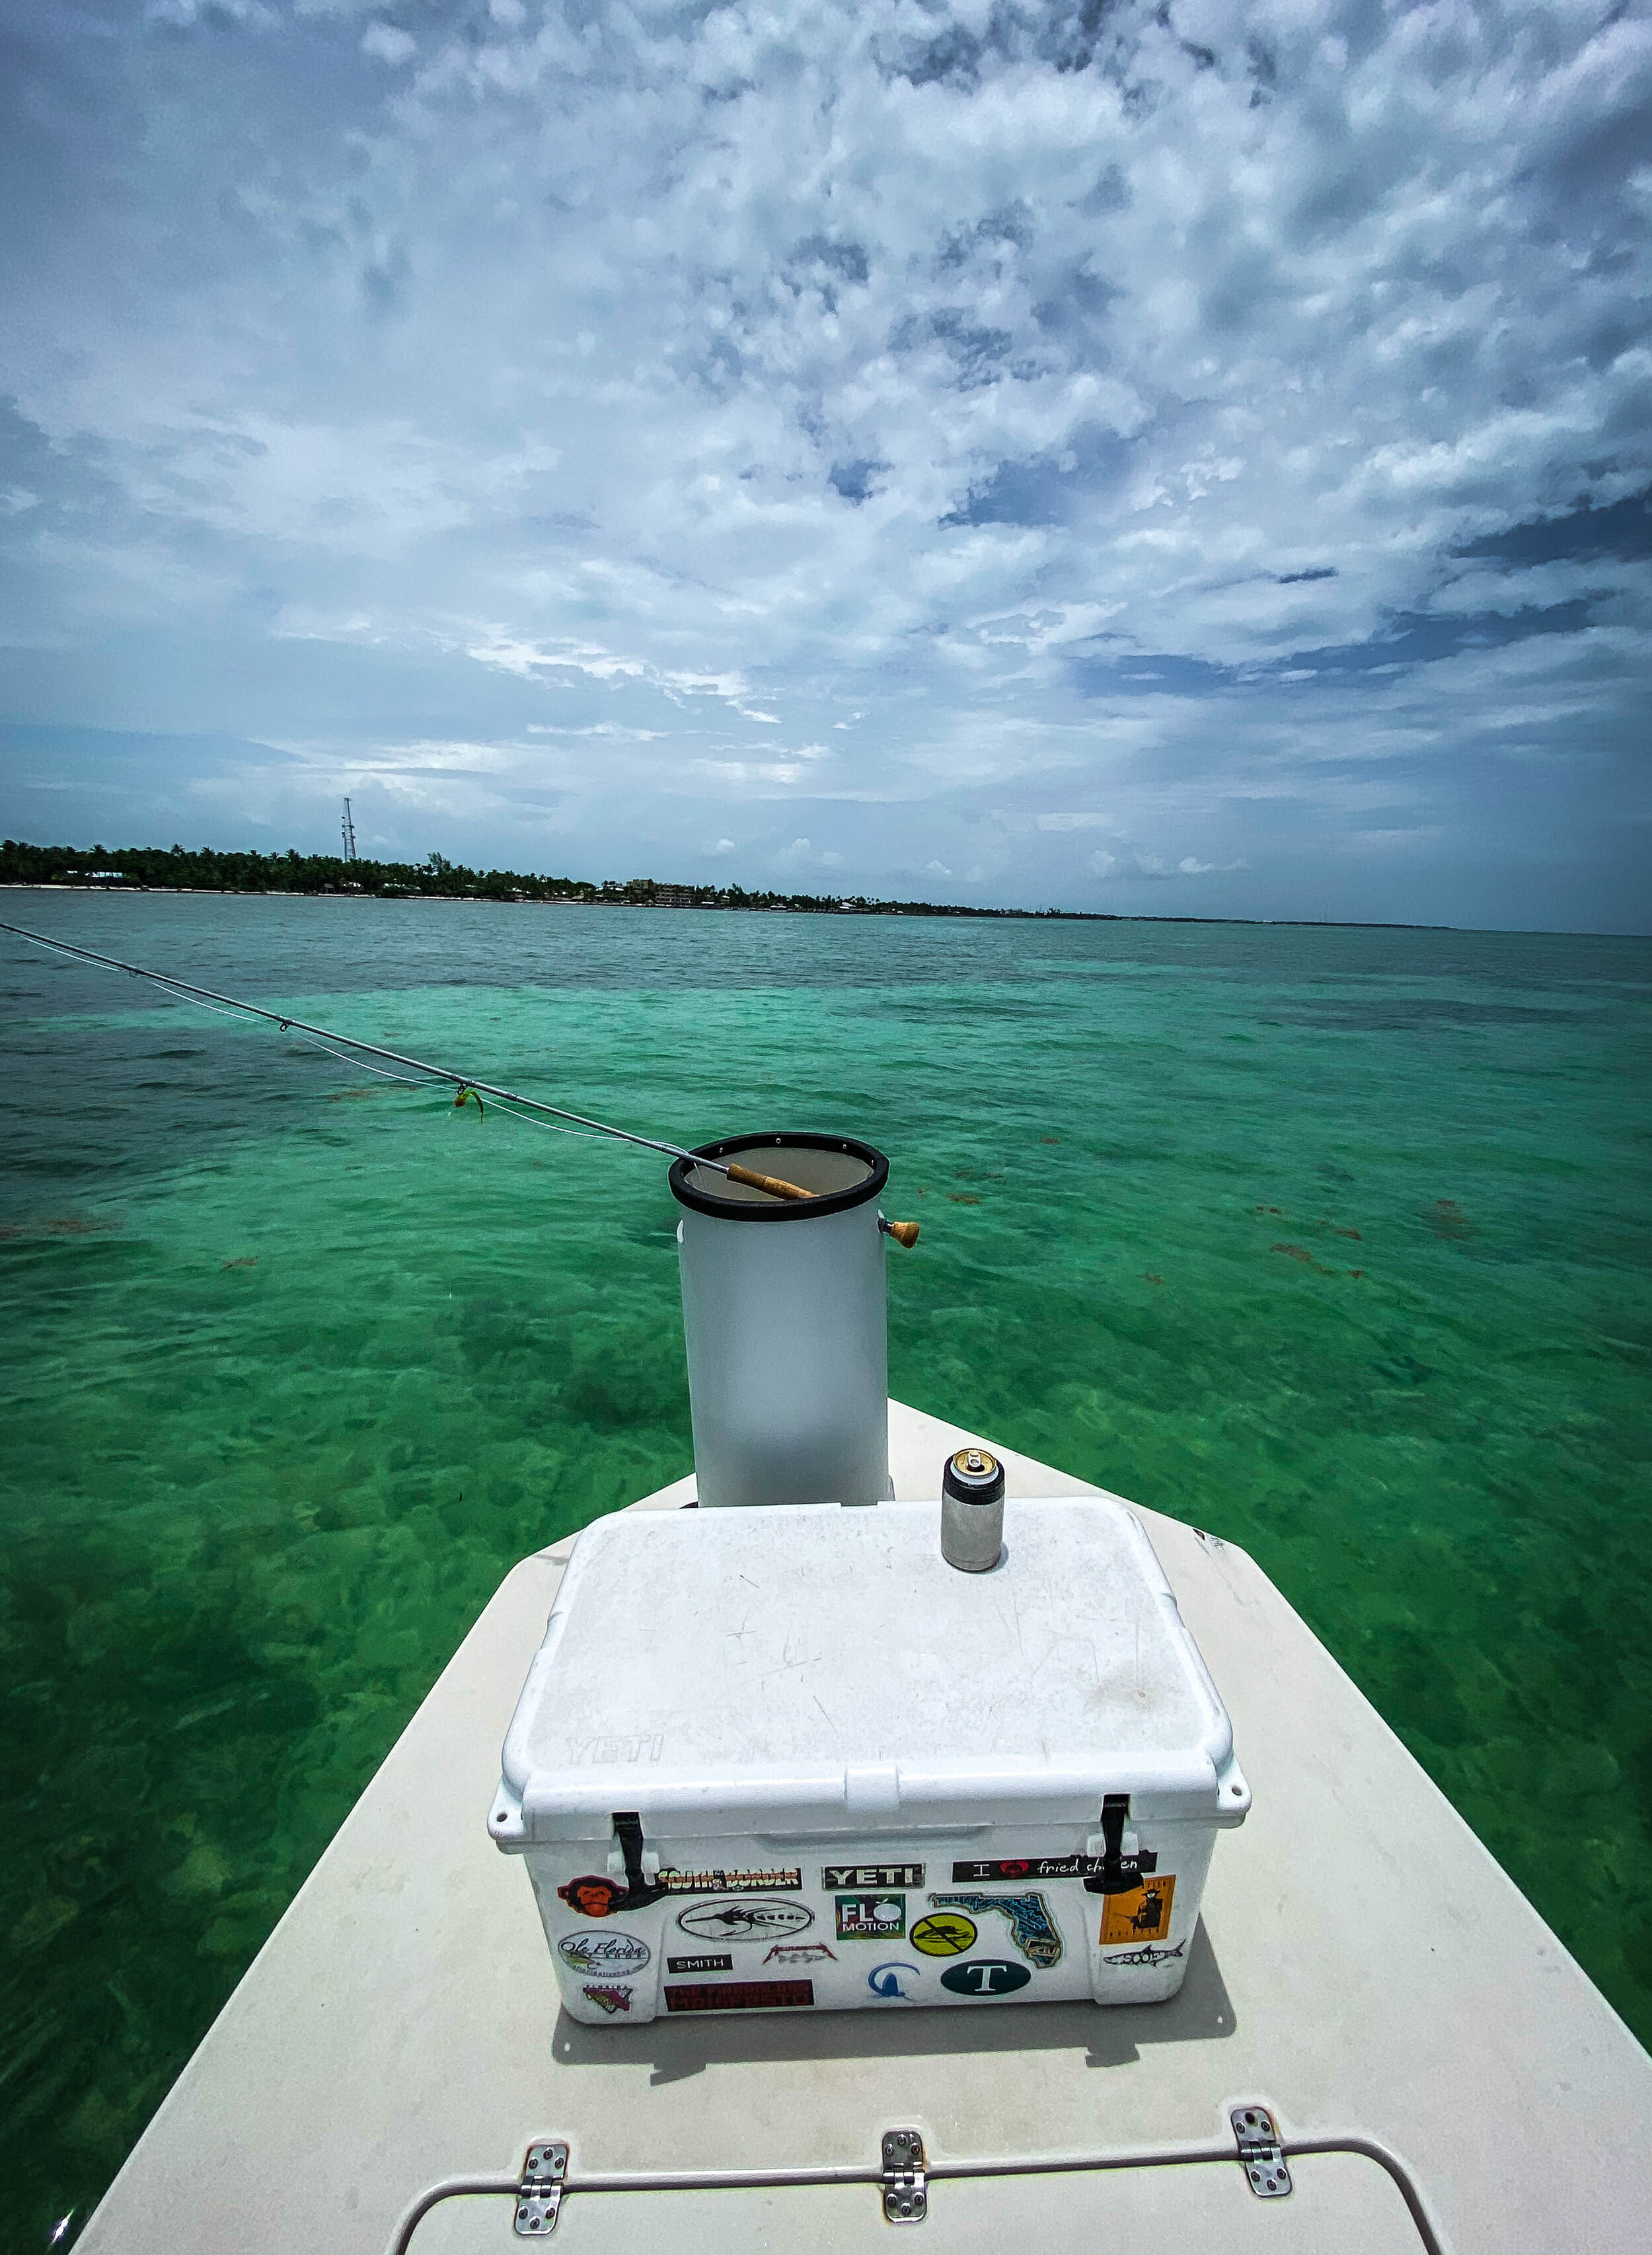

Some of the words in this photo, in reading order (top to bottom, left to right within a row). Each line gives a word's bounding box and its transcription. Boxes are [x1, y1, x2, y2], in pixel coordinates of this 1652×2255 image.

[566, 1734, 665, 1765] YETI
[973, 1863, 990, 1877] I
[1037, 1859, 1079, 1874] fried
[1087, 1857, 1137, 1873] chien
[726, 1868, 799, 1888] BORDER
[829, 1868, 913, 1885] YETI
[843, 1922, 899, 1931] MOTION
[560, 1938, 589, 1953] Ole
[593, 1939, 646, 1954] Florida
[676, 1958, 724, 1970] SMITH
[967, 1965, 1007, 1991] T
